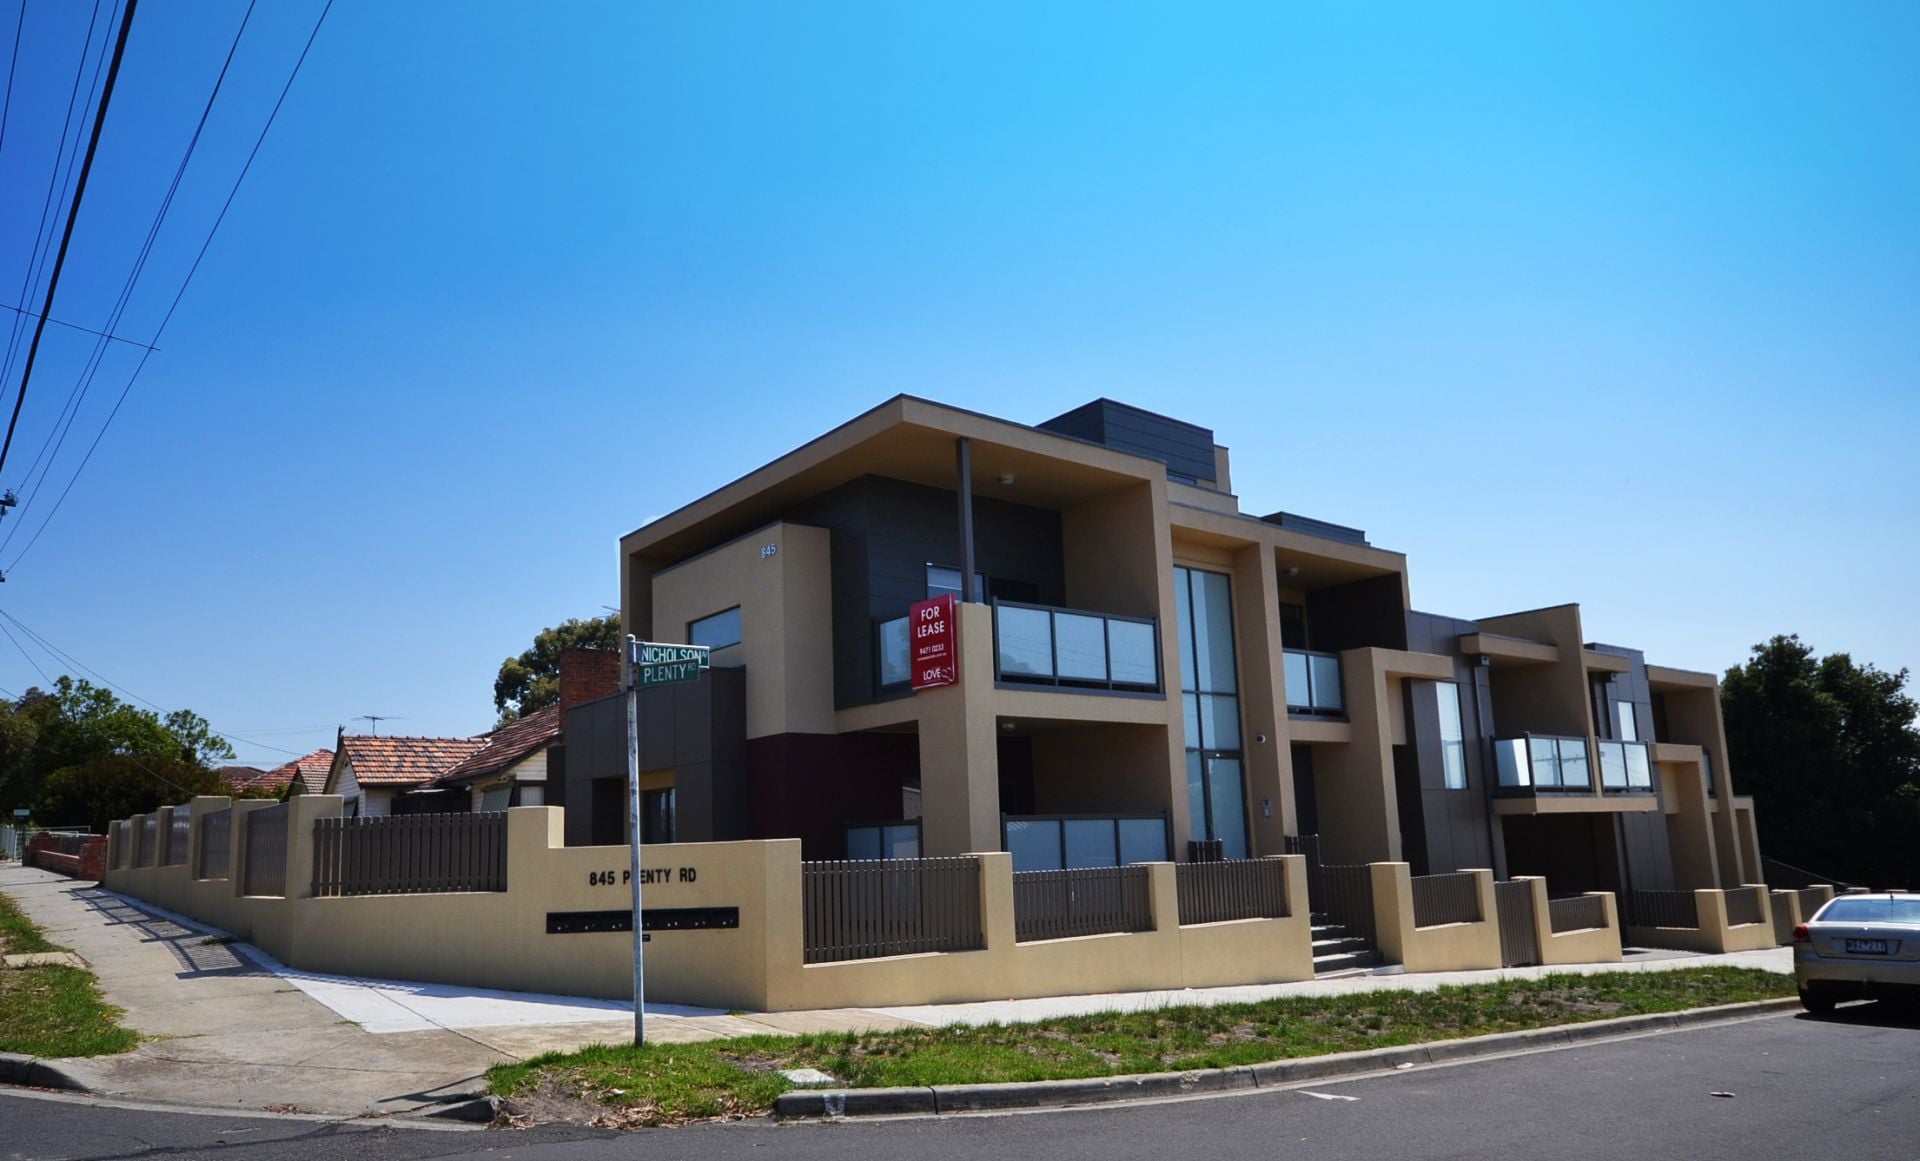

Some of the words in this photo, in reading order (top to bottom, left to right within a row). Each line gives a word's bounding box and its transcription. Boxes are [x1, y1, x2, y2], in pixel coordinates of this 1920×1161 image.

[761, 543, 776, 559] 845
[921, 606, 940, 621] FOR
[917, 620, 945, 638] LEASE
[641, 646, 702, 664] NICHOLSON
[644, 663, 687, 683] PLENTY
[687, 662, 697, 671] RD
[923, 667, 941, 681] LOVE
[589, 871, 615, 886] 845
[622, 868, 672, 885] PENTY
[679, 867, 697, 882] RD
